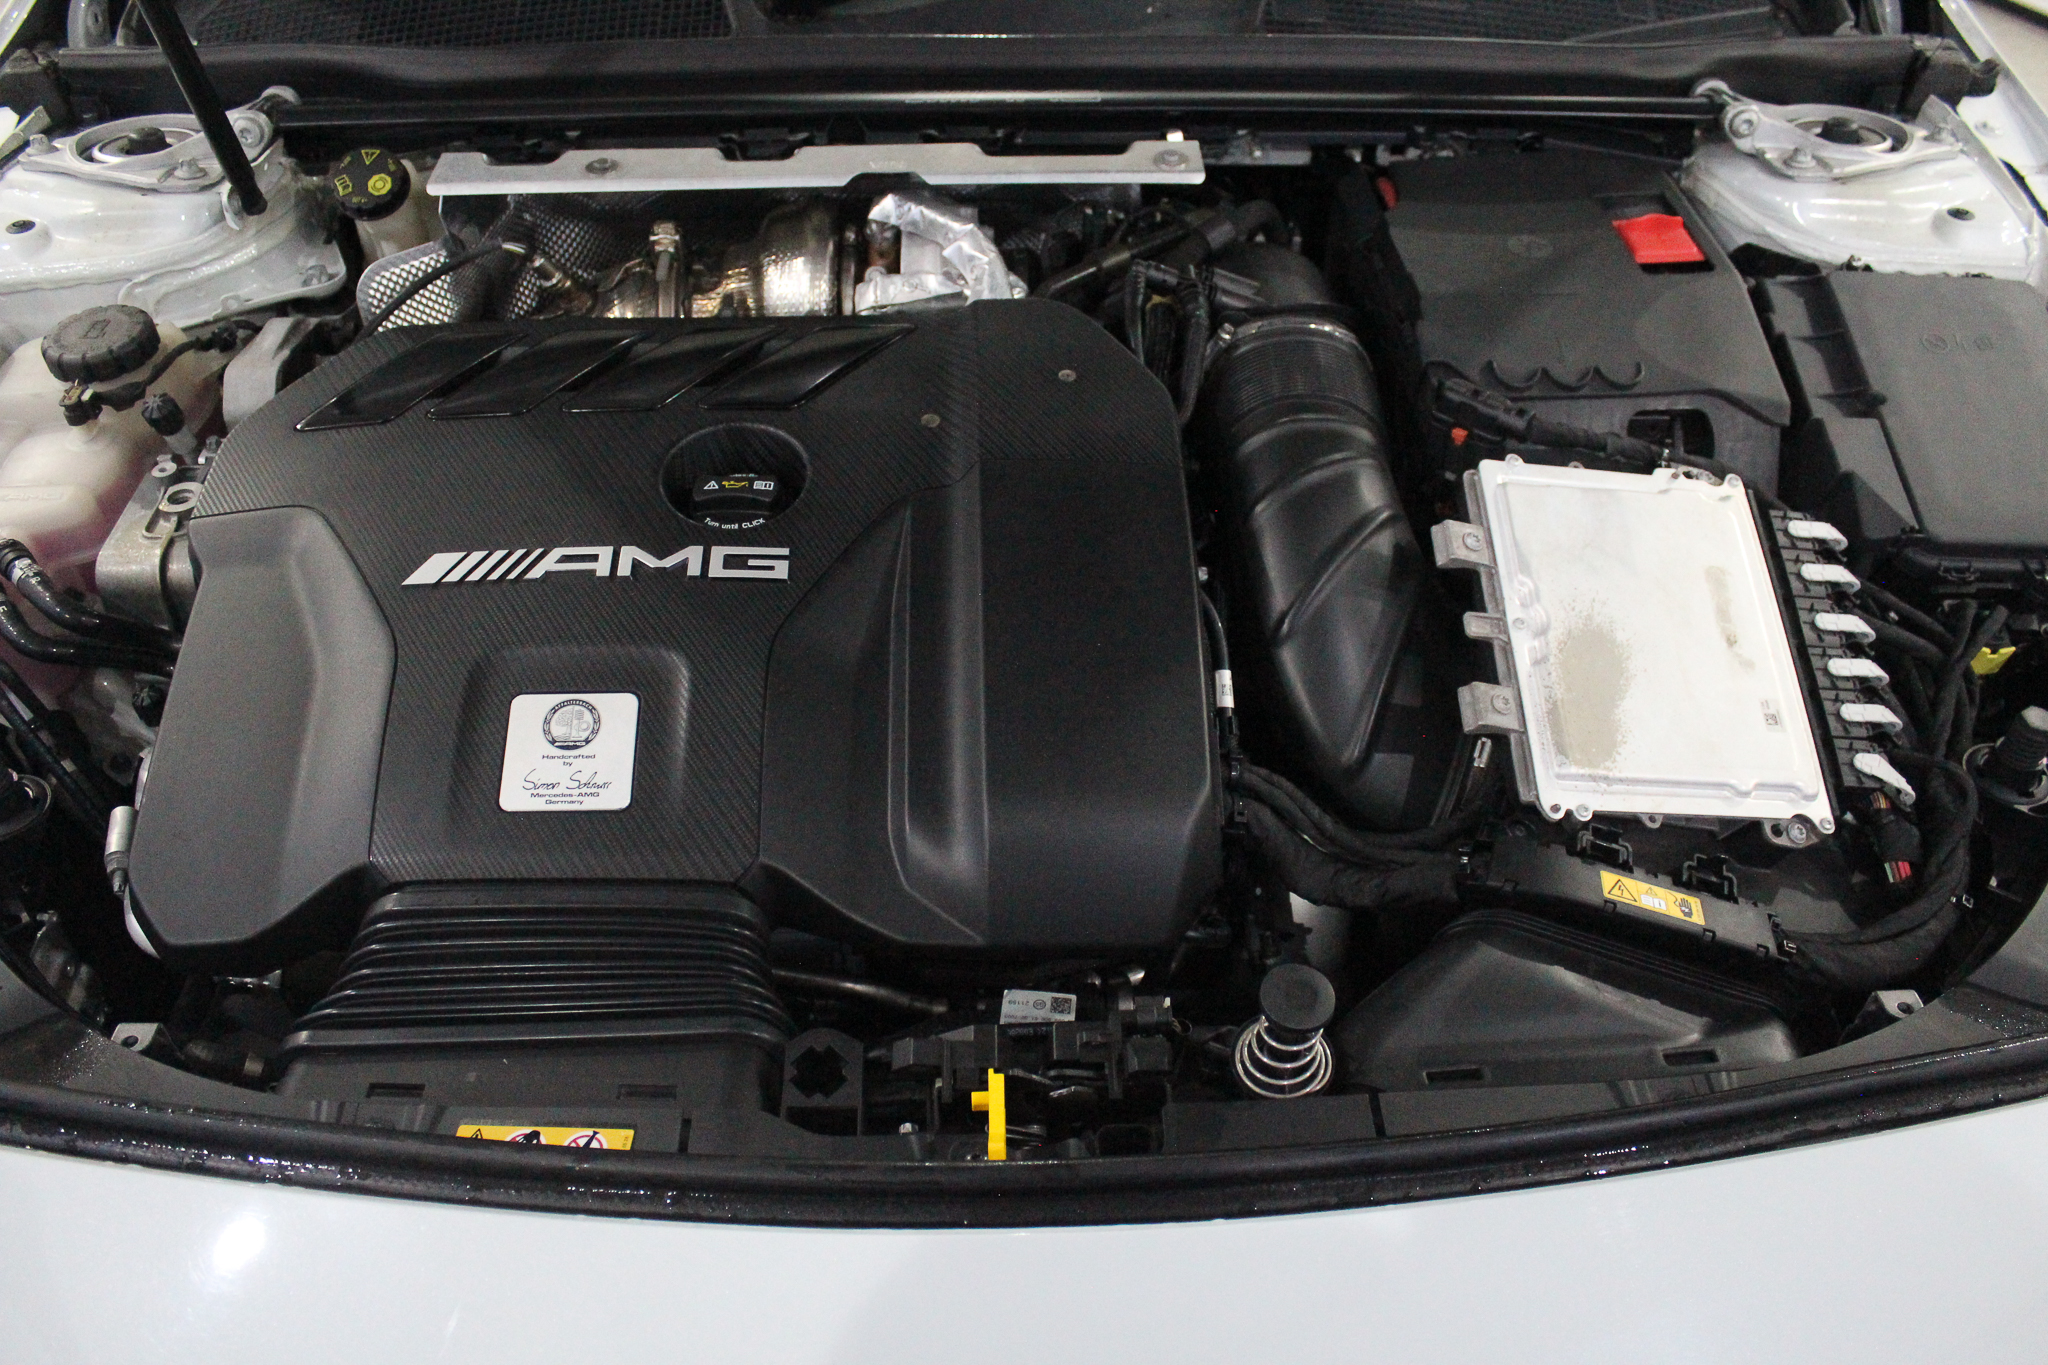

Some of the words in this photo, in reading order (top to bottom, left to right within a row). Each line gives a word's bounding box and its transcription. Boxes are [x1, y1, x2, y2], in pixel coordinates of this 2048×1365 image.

[704, 517, 720, 527] Turn
[742, 517, 766, 529] CLICK
[523, 545, 790, 580] AMG
